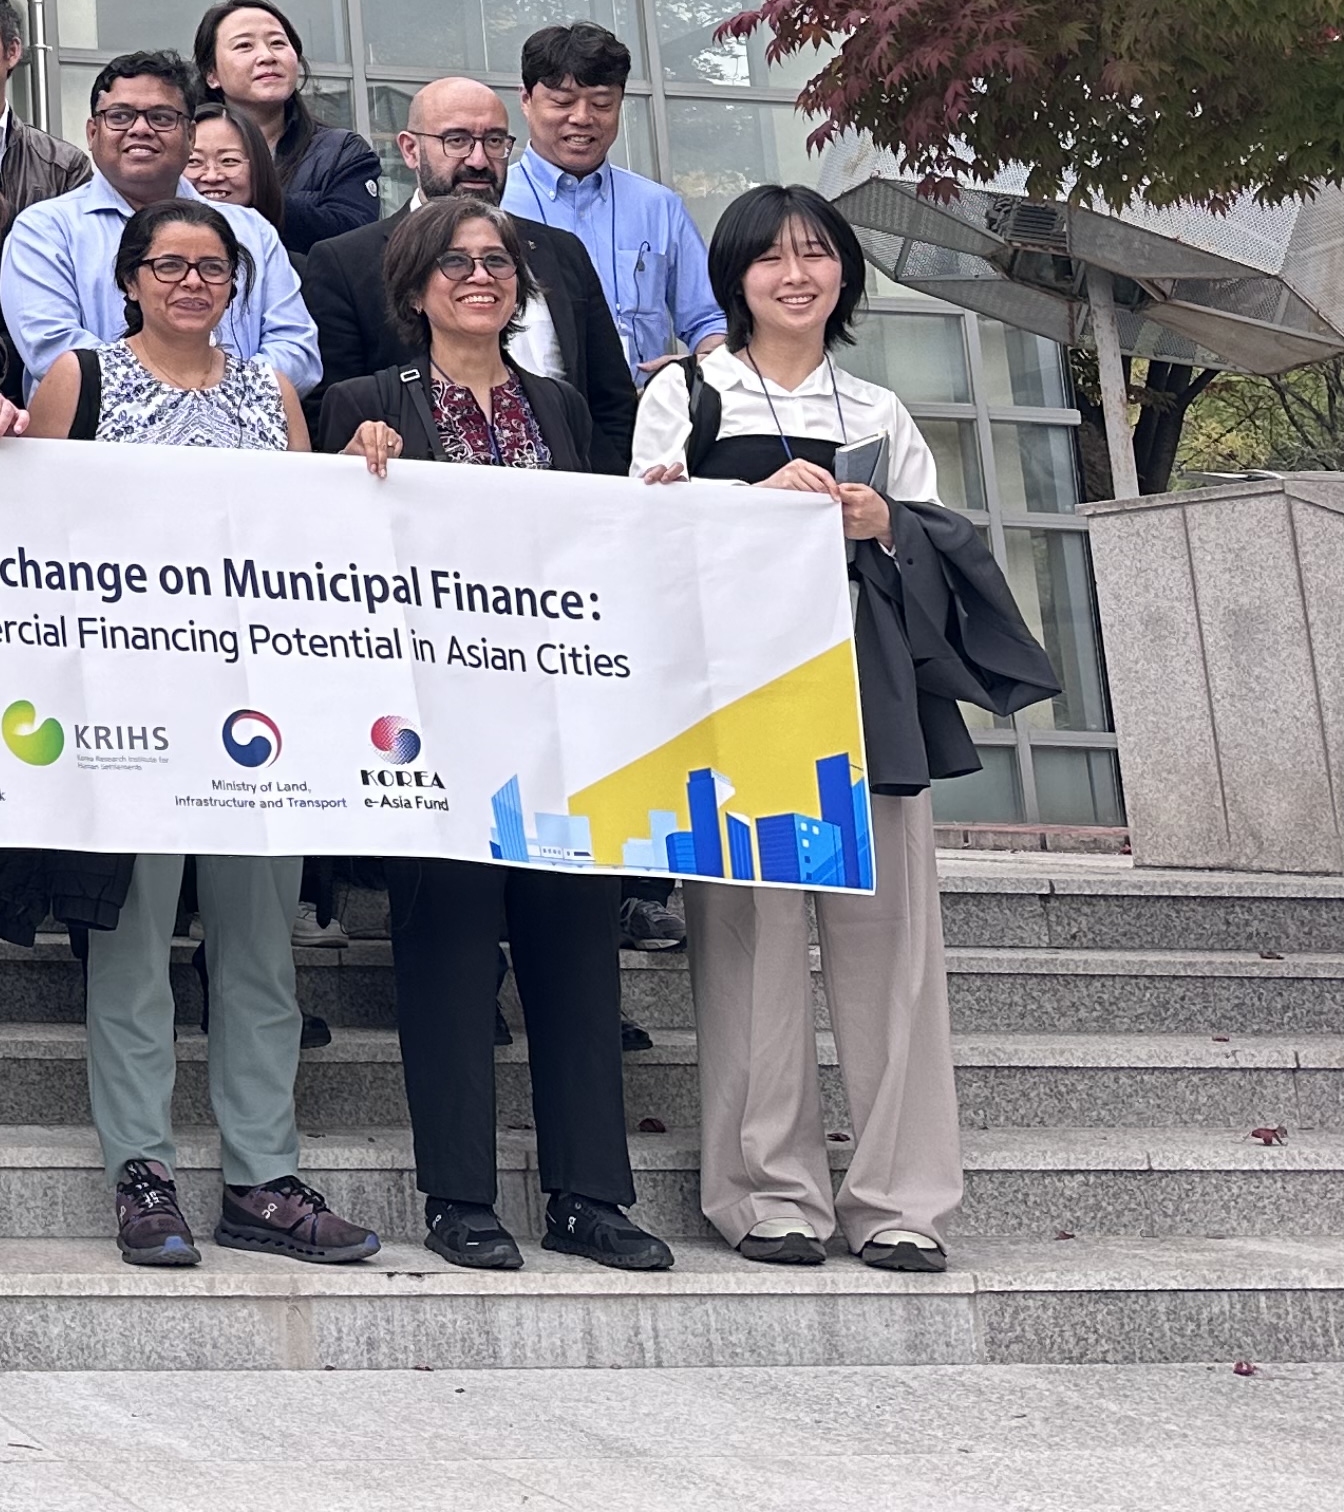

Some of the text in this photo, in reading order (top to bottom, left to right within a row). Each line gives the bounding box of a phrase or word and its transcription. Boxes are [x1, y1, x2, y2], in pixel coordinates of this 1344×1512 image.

[160, 565, 211, 595] on
[224, 558, 422, 613] Municipal
[431, 570, 600, 620] Finance:
[78, 617, 238, 663] Financing
[249, 625, 402, 659] Potential
[411, 629, 435, 663] in
[448, 636, 526, 672] Asian
[537, 644, 630, 677] Cities
[75, 725, 168, 750] KRIHS
[212, 780, 311, 794] Ministry of Land,
[361, 770, 445, 789] KOREA
[175, 796, 347, 809] Infrastructure and Transport
[365, 795, 449, 811] e-Asia Fund
